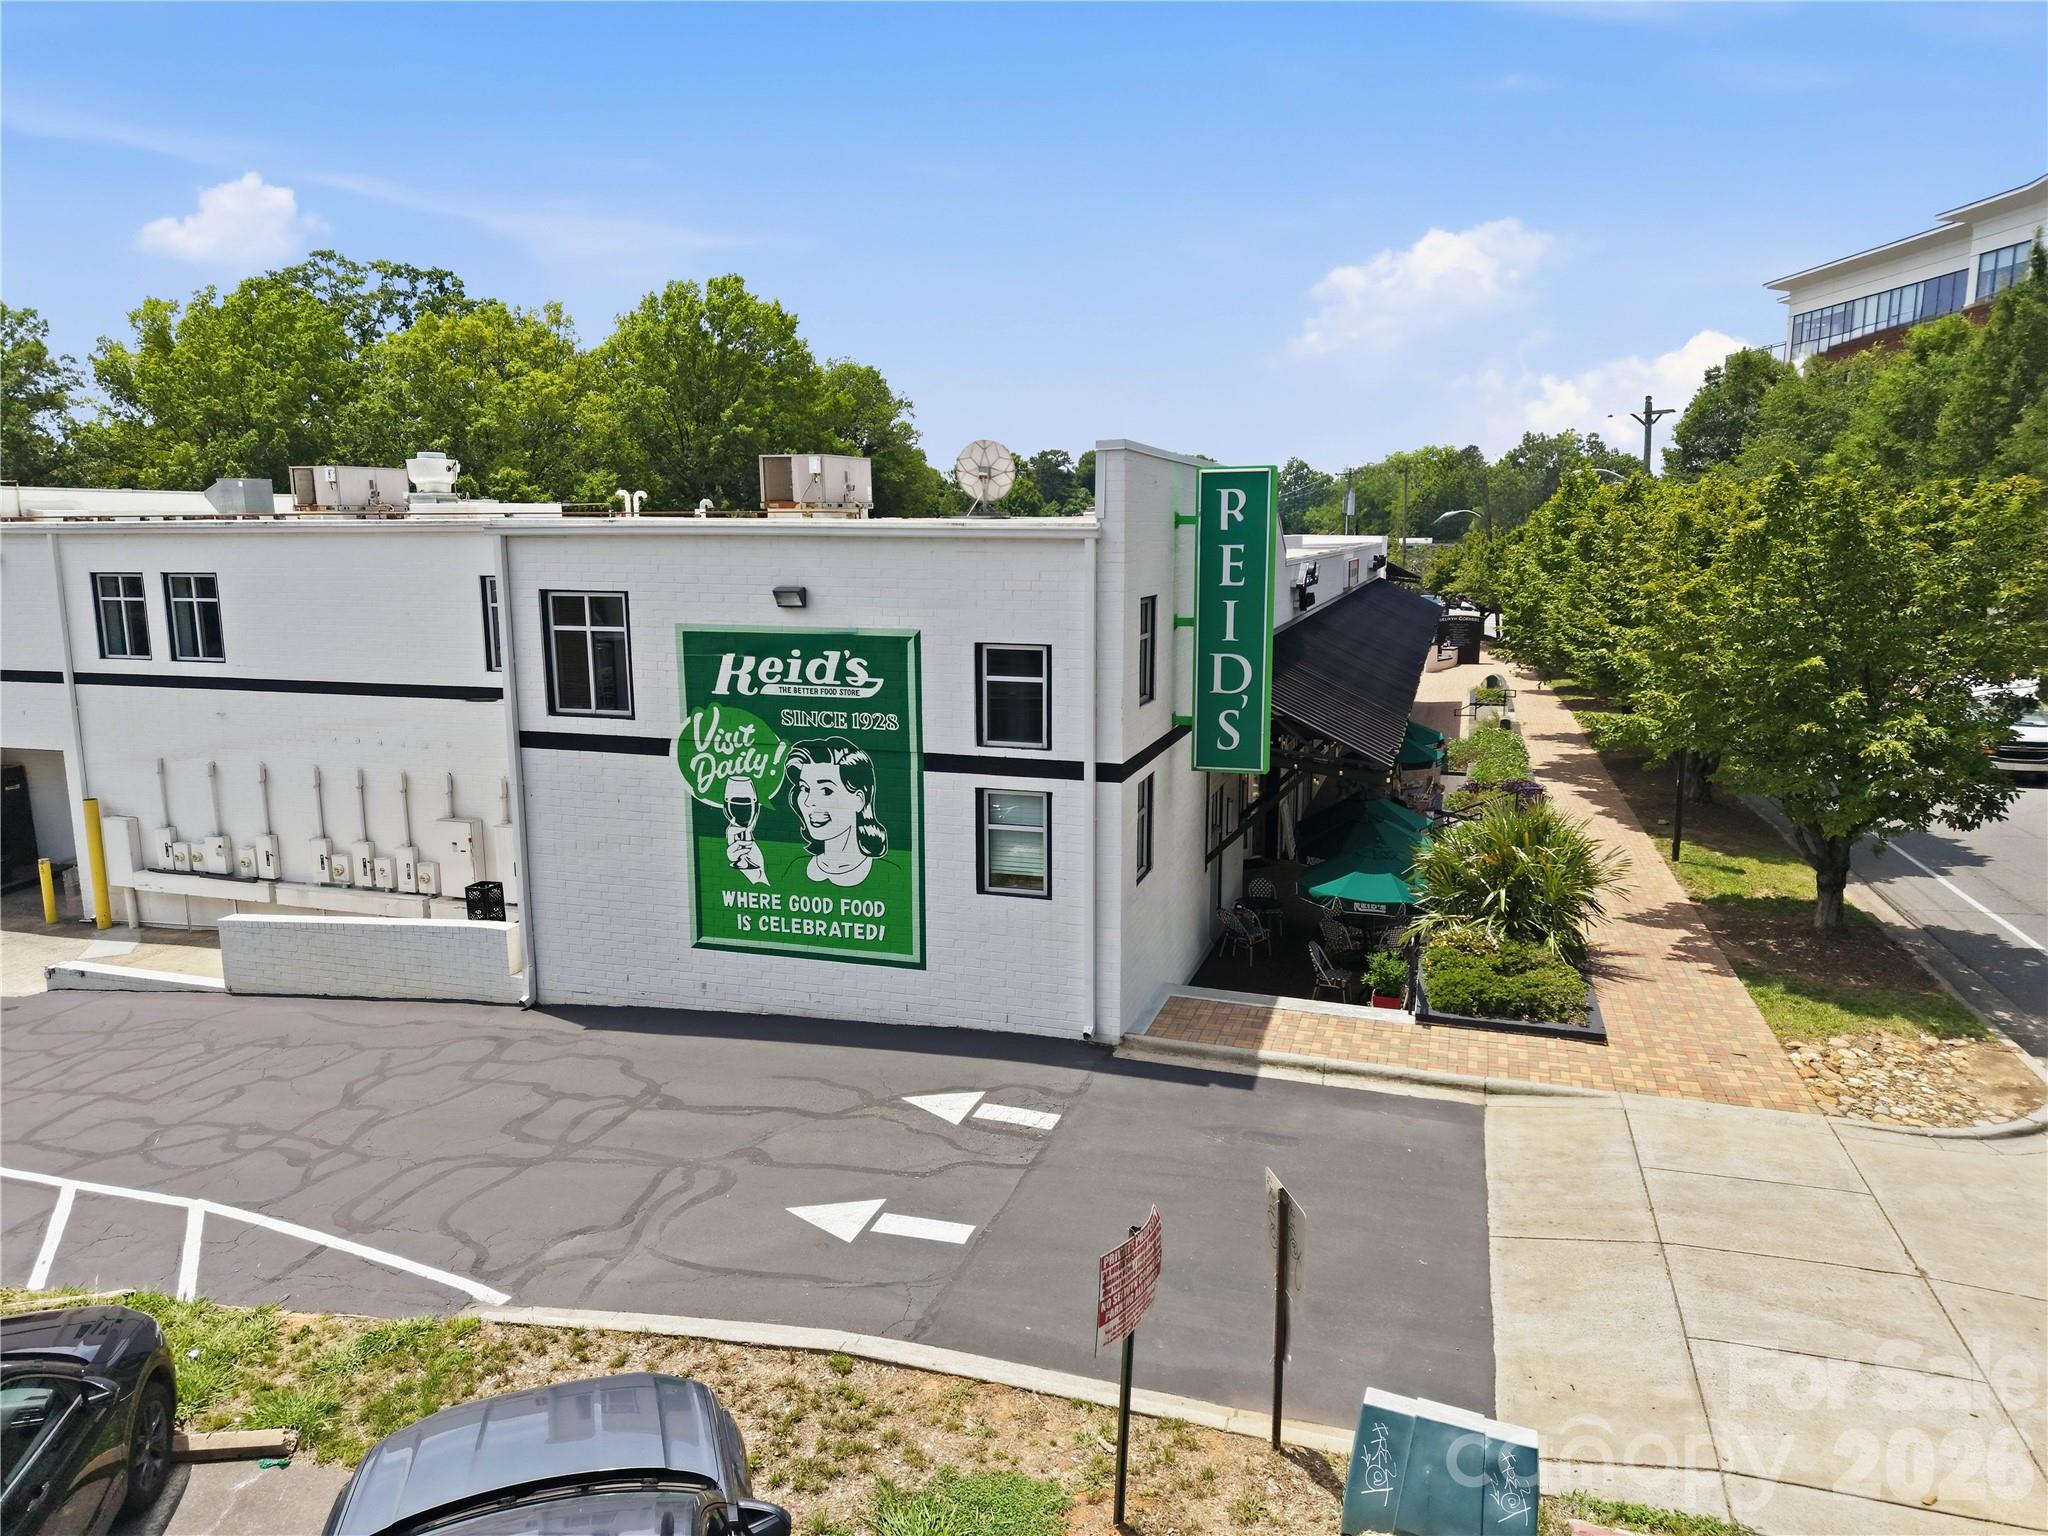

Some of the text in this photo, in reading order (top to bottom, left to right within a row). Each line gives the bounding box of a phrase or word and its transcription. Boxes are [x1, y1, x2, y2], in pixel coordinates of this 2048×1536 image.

[1208, 488, 1253, 751] REID'S
[711, 649, 884, 696] Reid's
[778, 686, 791, 694] THE
[793, 687, 818, 695] BETTER
[820, 688, 837, 696] FOOD
[693, 706, 756, 755] Visit
[781, 709, 900, 731] SINCE 1928
[721, 890, 885, 918] WHERE GOOD FOOD
[737, 914, 751, 931] IS
